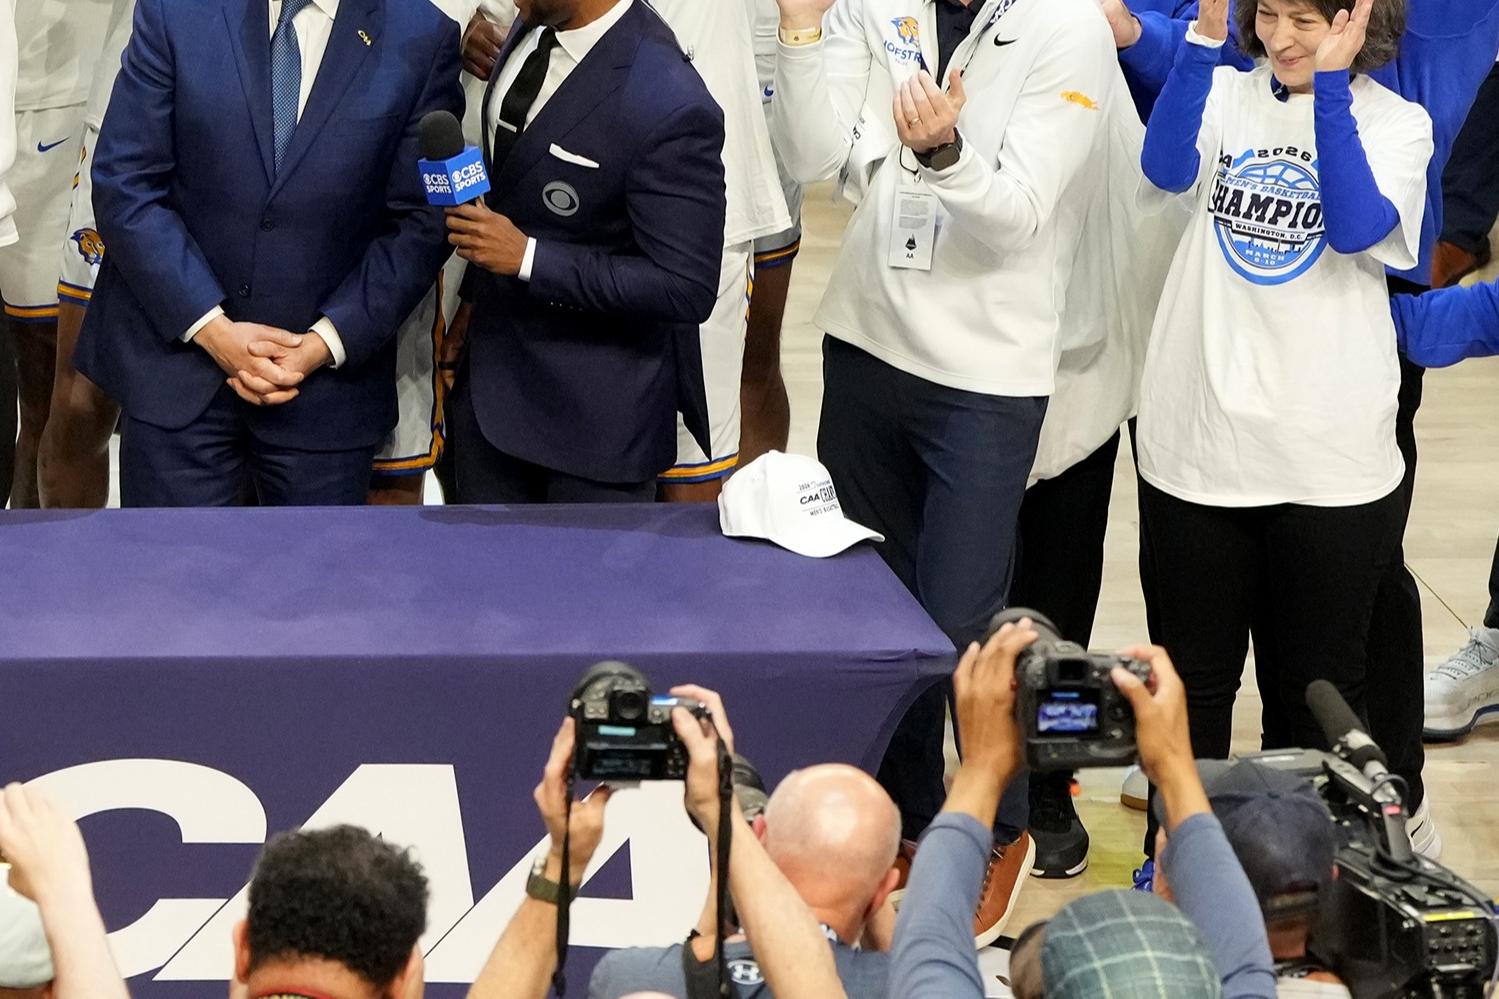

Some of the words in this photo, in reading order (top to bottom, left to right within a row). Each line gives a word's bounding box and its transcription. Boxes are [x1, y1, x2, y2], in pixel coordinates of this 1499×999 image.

[884, 40, 922, 63] OFSTR
[1257, 146, 1312, 162] 2026
[461, 161, 483, 178] CBS
[431, 174, 449, 185] CBS
[455, 172, 486, 192] SPORTS
[426, 185, 452, 194] SPORTS
[1225, 176, 1257, 190] MEN'S
[1260, 185, 1320, 200] BASKETBA
[1212, 179, 1325, 229] HAMPIO
[1235, 223, 1287, 239] WASHINGTON,
[1245, 249, 1285, 260] MARCH
[800, 493, 820, 504] CAA
[13, 757, 715, 983] CAA
